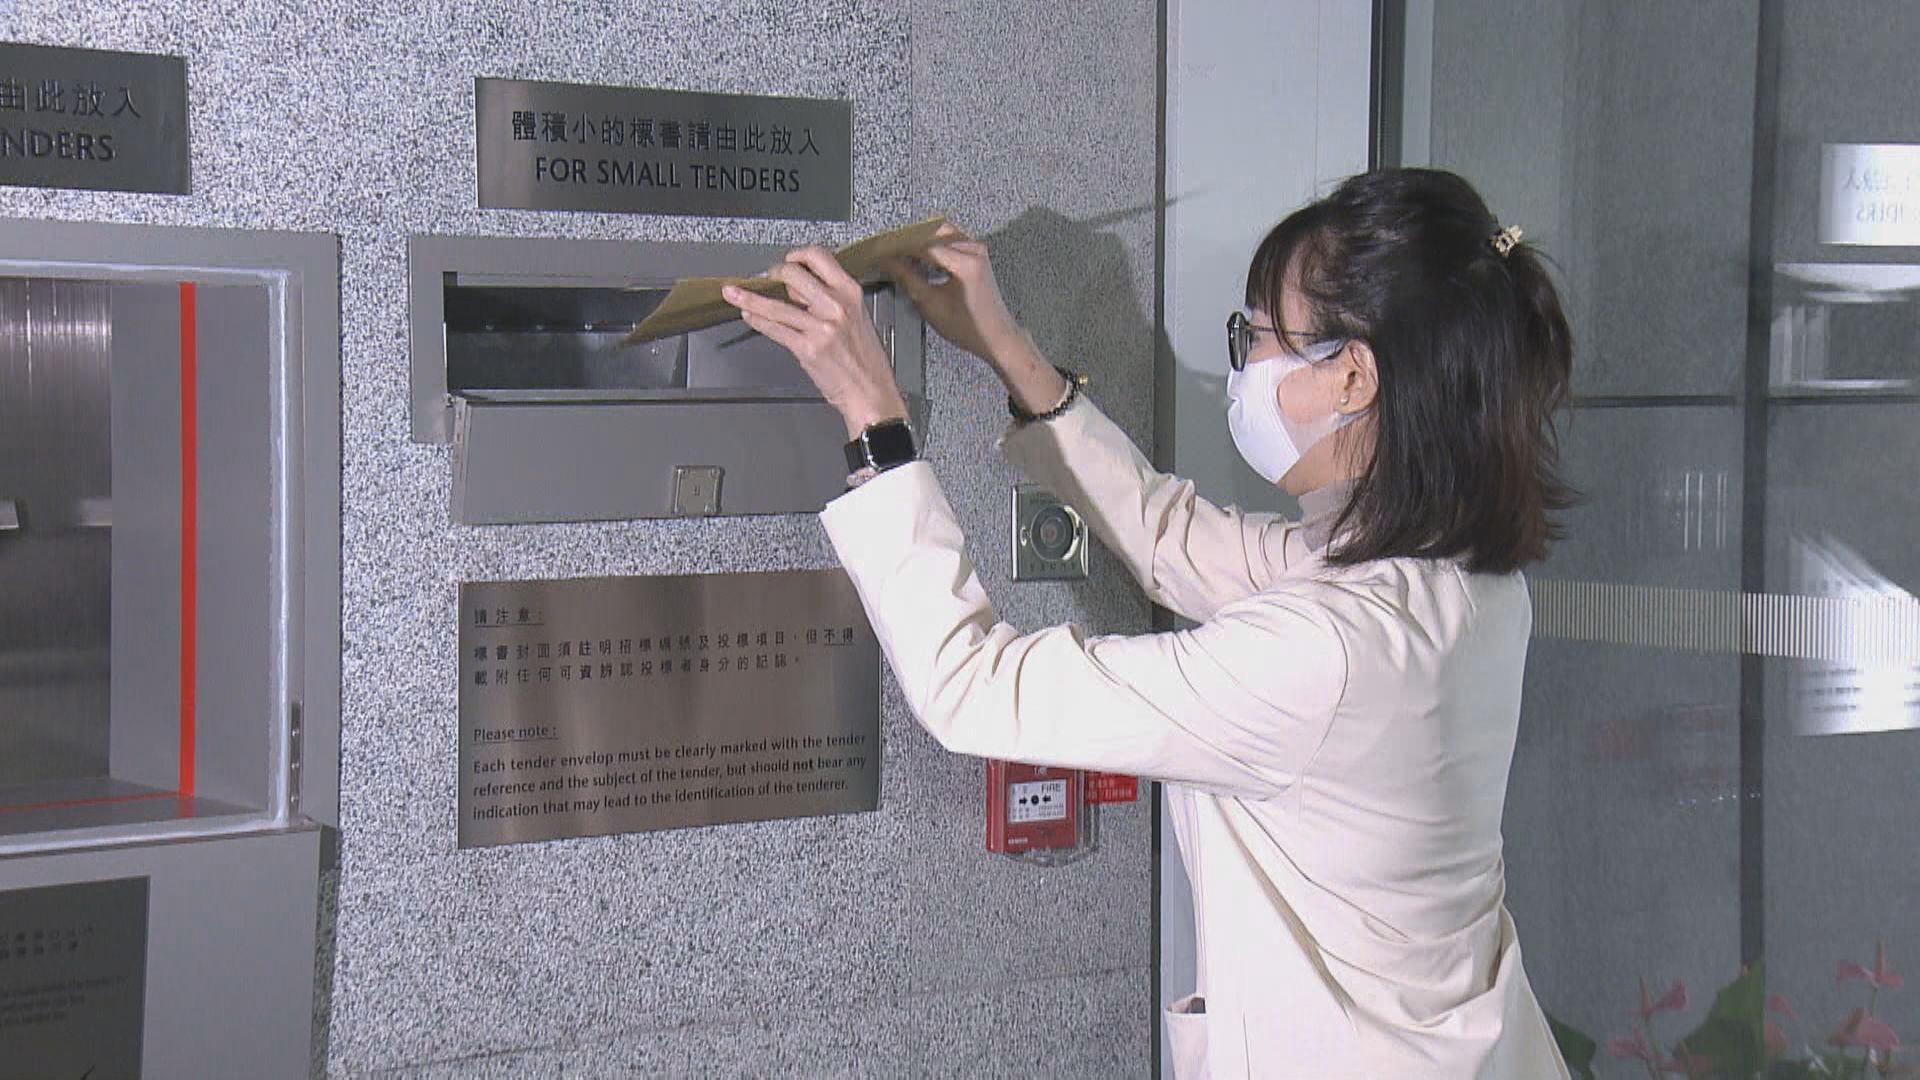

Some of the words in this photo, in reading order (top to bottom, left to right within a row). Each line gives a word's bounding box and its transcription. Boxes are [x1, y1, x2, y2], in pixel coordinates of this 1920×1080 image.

[0, 76, 142, 118] 由此放入
[1, 128, 117, 162] NDERS
[511, 110, 820, 156] 體積小的標書請由此放入
[535, 156, 588, 184] FOR
[596, 159, 682, 189] SMALL
[689, 164, 801, 193] TENDERS
[473, 728, 515, 741] Please
[473, 758, 505, 773] Each
[511, 755, 556, 770] tender
[561, 751, 614, 766] envelop
[618, 748, 649, 762] must
[655, 745, 670, 759] be
[675, 743, 716, 758] clearly
[720, 739, 767, 754] marked
[771, 736, 798, 751] with
[803, 736, 822, 749] the
[827, 733, 866, 746] tender
[473, 781, 535, 797] reference
[539, 776, 563, 791] and
[568, 773, 589, 789] the
[593, 771, 636, 788] subject
[640, 769, 652, 783] of
[656, 768, 677, 782] the
[681, 765, 722, 779] tender,
[727, 763, 746, 776] but
[751, 759, 789, 774] should
[793, 759, 814, 773] not
[817, 756, 843, 769] bear
[846, 756, 866, 769] any
[473, 803, 539, 820] indication
[543, 800, 569, 814] that
[573, 799, 600, 814] may
[604, 795, 630, 808] lead
[634, 793, 647, 806] to
[651, 791, 672, 805] the
[675, 783, 754, 803] identification
[759, 781, 770, 795] of
[774, 780, 793, 793] the
[797, 778, 848, 793] tenderer.
